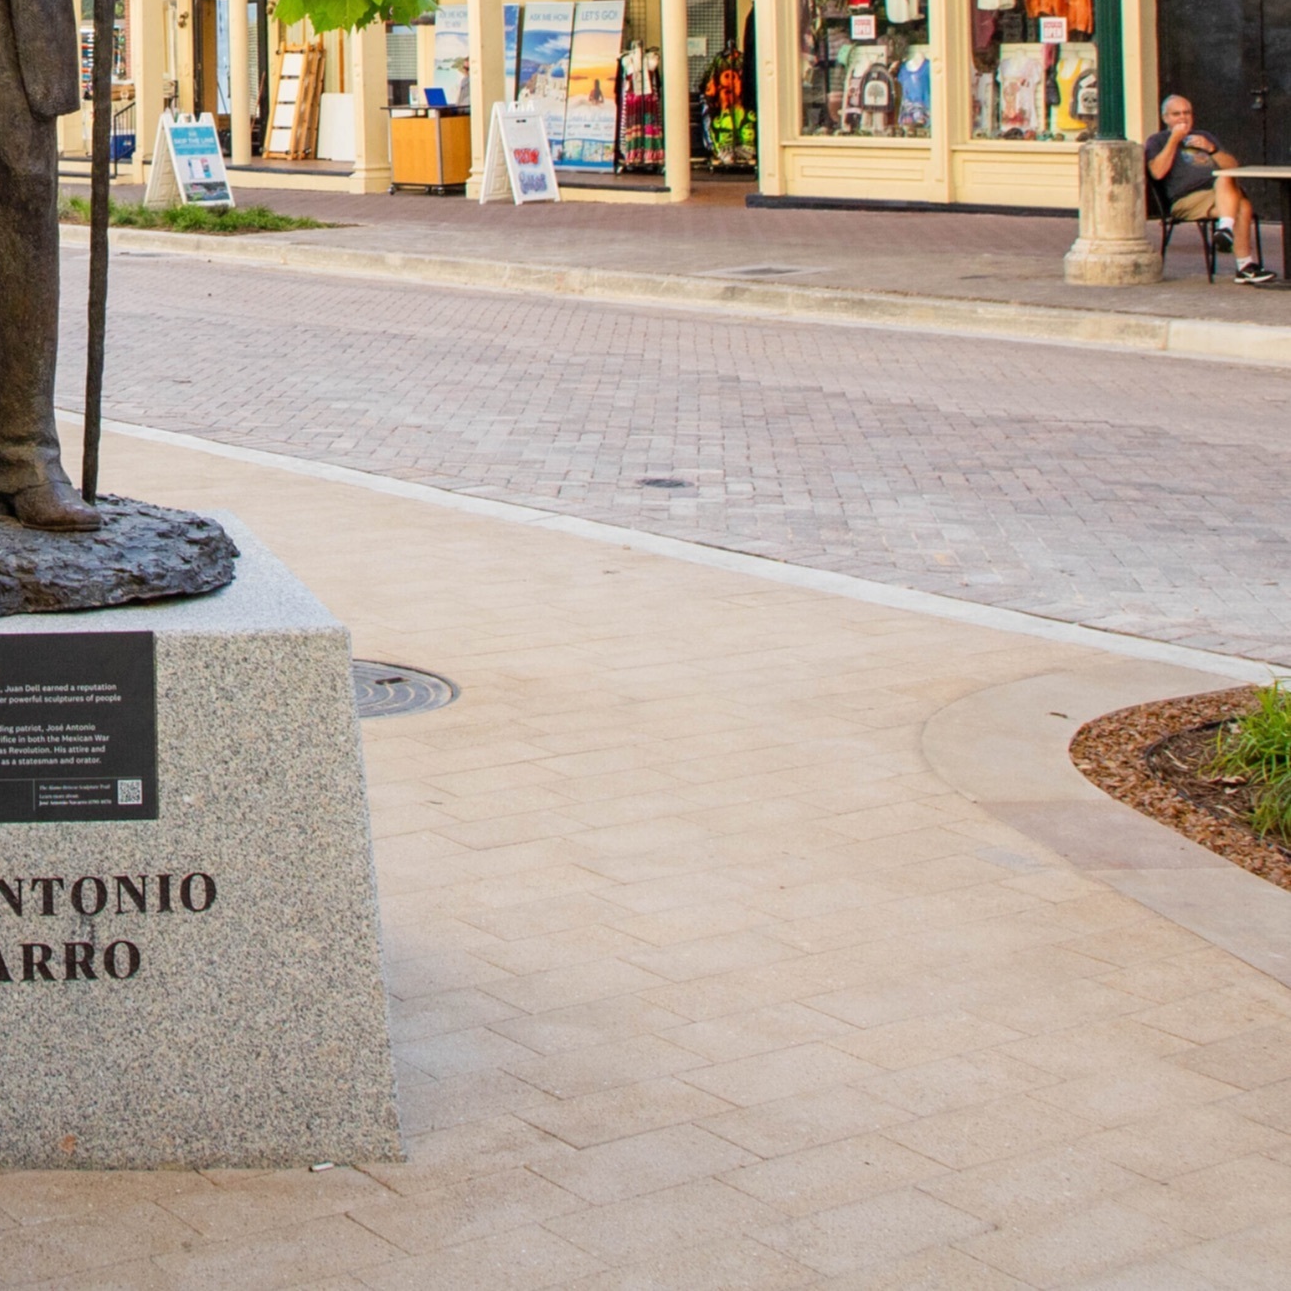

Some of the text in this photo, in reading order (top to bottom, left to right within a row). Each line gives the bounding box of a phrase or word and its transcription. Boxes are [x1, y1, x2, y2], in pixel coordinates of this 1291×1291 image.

[581, 11, 600, 21] LET'S
[854, 25, 871, 34] OPEN
[1043, 27, 1063, 37] OPEN
[24, 684, 40, 692] Dell
[42, 684, 68, 692] earned
[76, 683, 117, 692] reputation
[8, 695, 42, 704] powerful
[44, 695, 84, 704] sculptures
[85, 694, 94, 702] of
[95, 694, 121, 703] people
[15, 725, 44, 733] patriot,
[65, 723, 95, 731] Antonio
[27, 735, 45, 743] both
[62, 734, 93, 742] Mexican
[8, 746, 52, 754] Revolution.
[68, 745, 88, 753] attire
